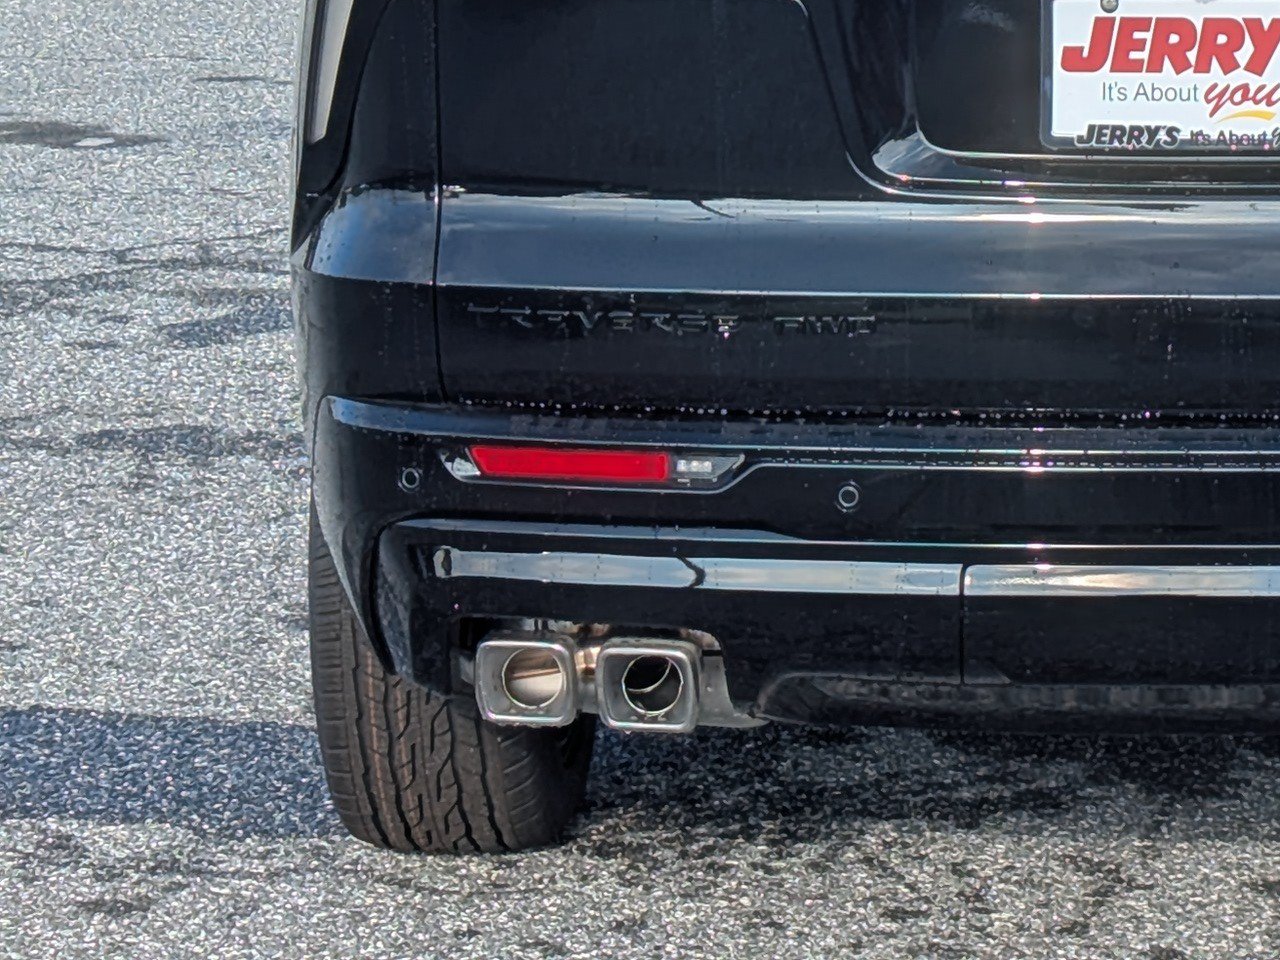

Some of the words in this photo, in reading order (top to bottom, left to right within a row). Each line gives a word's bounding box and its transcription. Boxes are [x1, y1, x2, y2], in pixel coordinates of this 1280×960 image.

[1102, 81, 1128, 102] It's
[1134, 82, 1199, 102] About
[1075, 123, 1182, 148] JERRY'S
[1216, 129, 1269, 145] About
